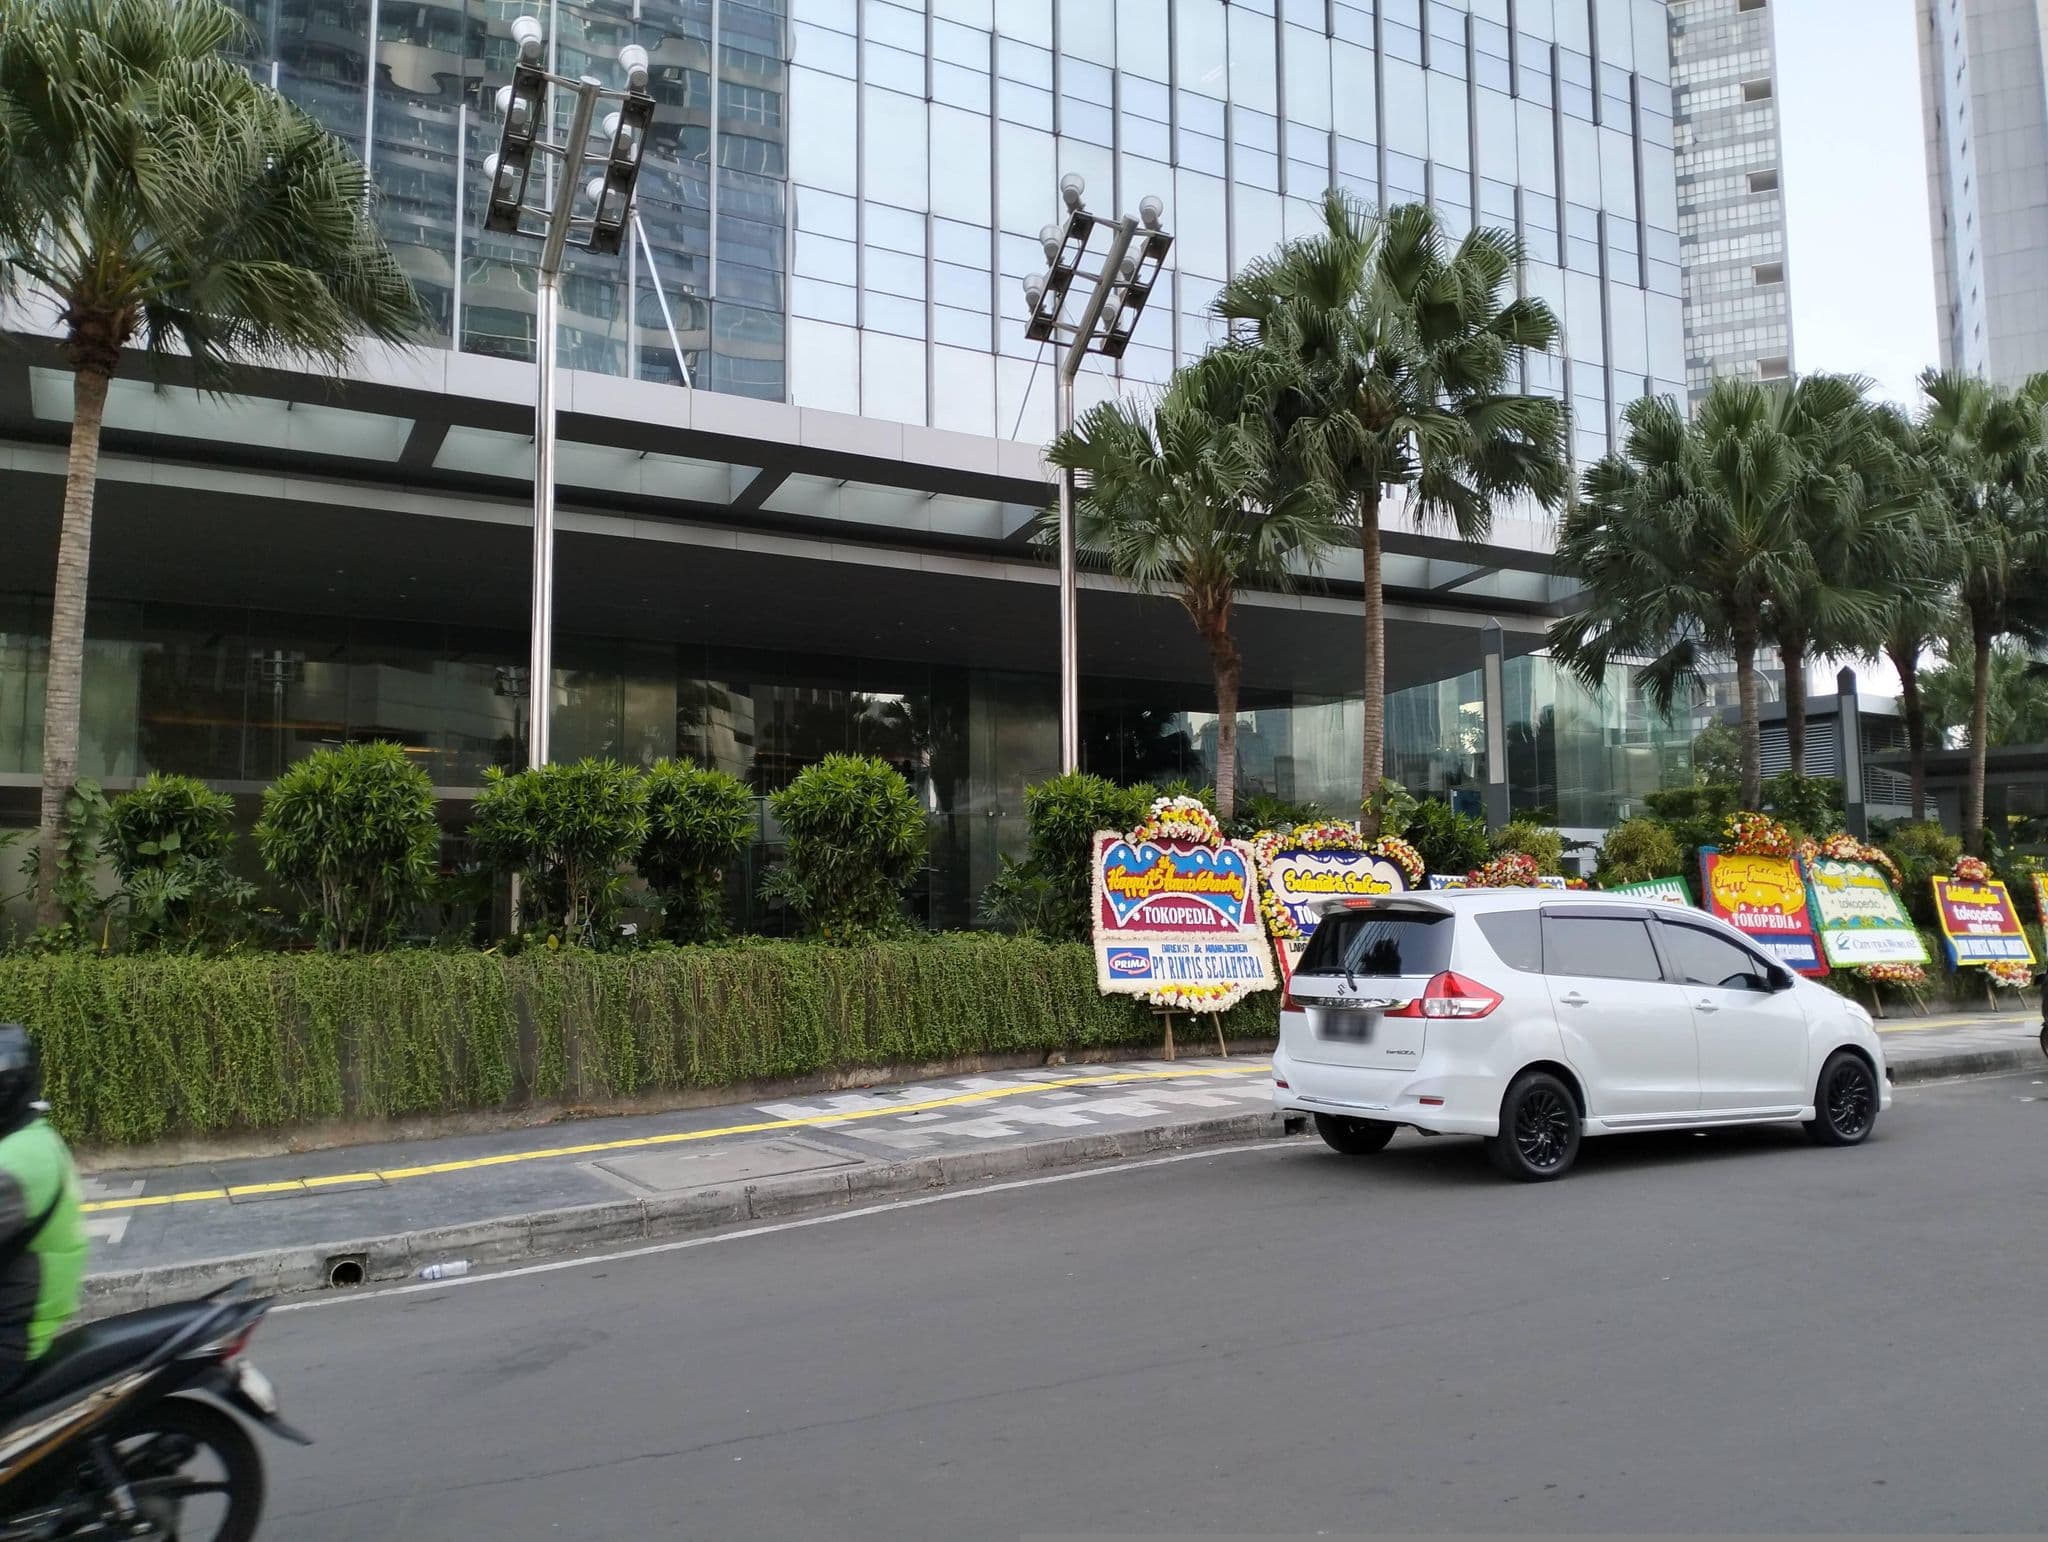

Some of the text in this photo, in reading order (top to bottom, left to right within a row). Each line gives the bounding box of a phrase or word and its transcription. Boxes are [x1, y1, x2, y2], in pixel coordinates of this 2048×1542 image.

[1839, 898, 1881, 910] tokopedia
[1143, 906, 1216, 925] TOKOPEDIA
[1731, 912, 1796, 929] TOKOPEDIA
[1953, 904, 2004, 924] tokopedia
[1114, 958, 1147, 969] PRIMA
[1152, 956, 1264, 979] PT RINTIS SEJAHTERA
